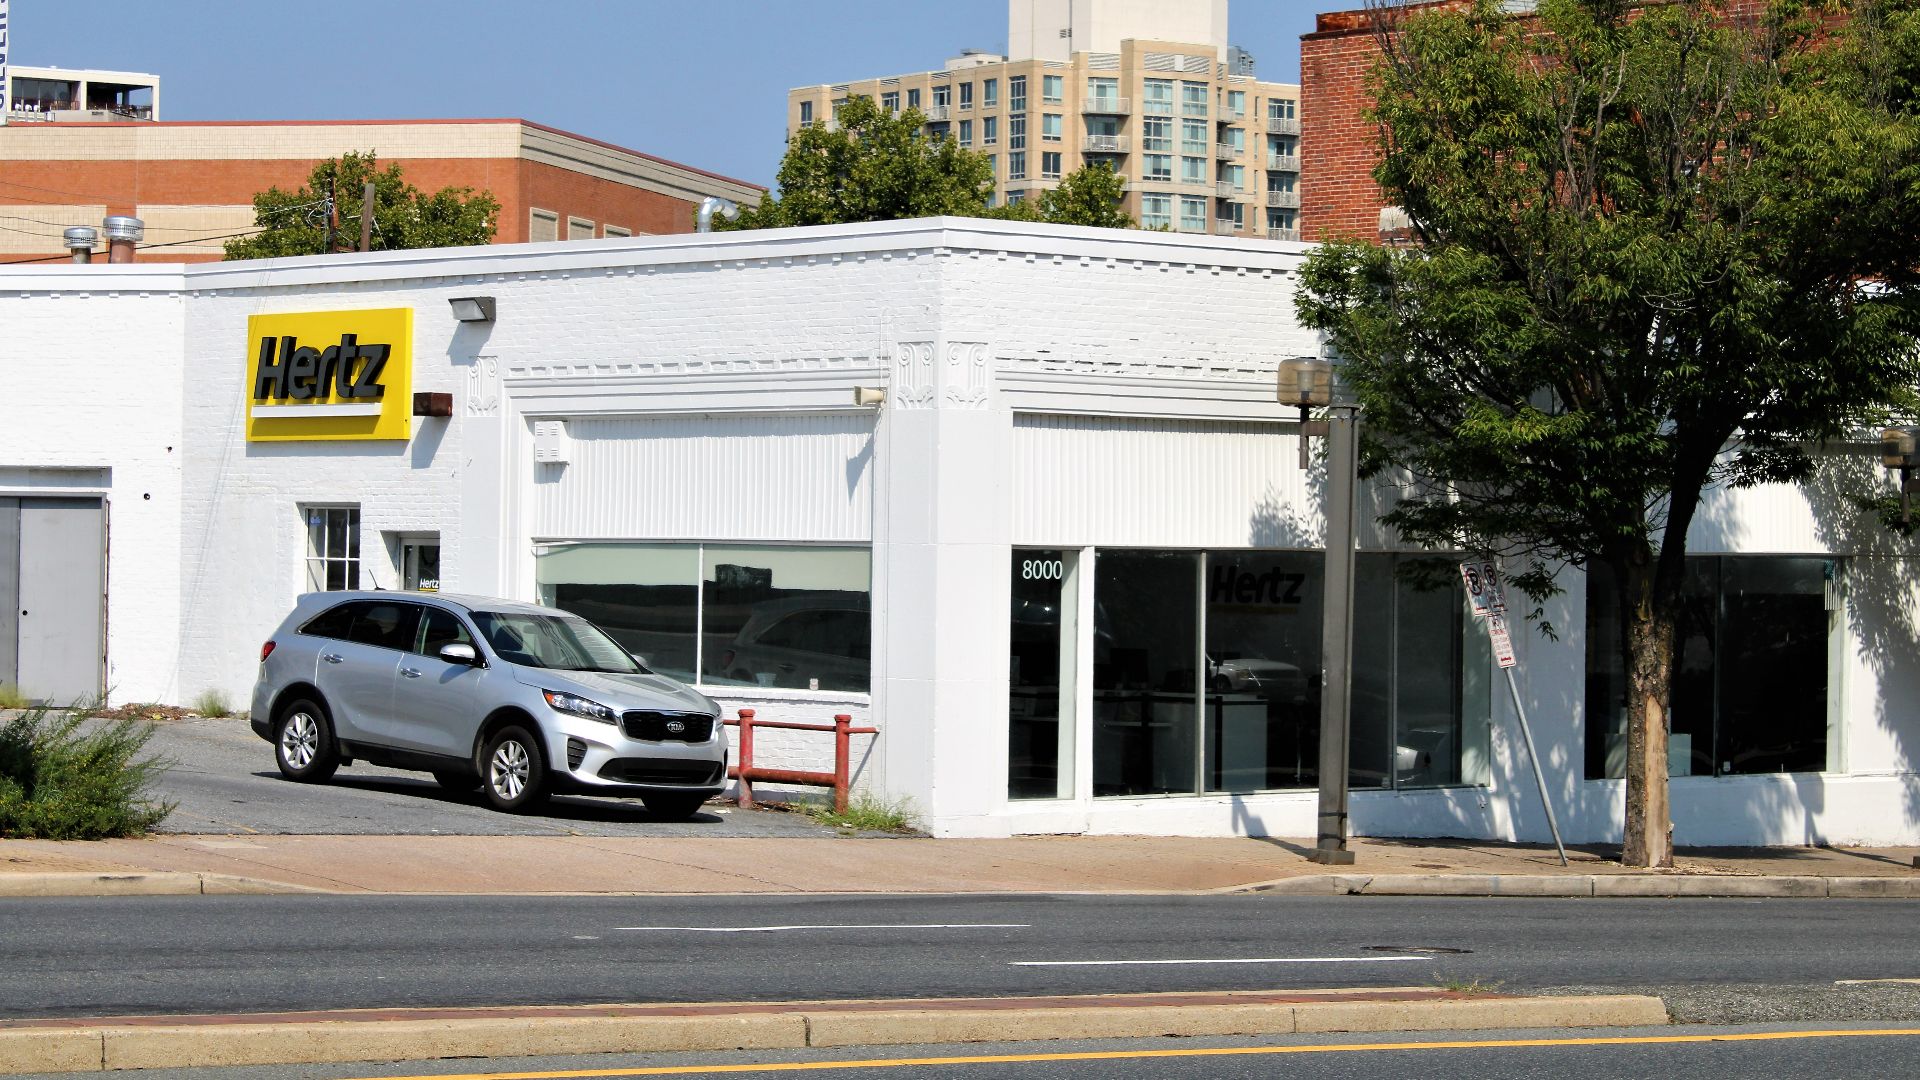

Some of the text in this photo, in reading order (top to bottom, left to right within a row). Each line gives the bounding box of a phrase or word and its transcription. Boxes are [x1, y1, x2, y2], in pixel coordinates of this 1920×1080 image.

[254, 334, 391, 399] Hertz
[420, 578, 439, 588] Hertz
[1022, 560, 1062, 579] 8000
[1210, 565, 1305, 604] Hertz
